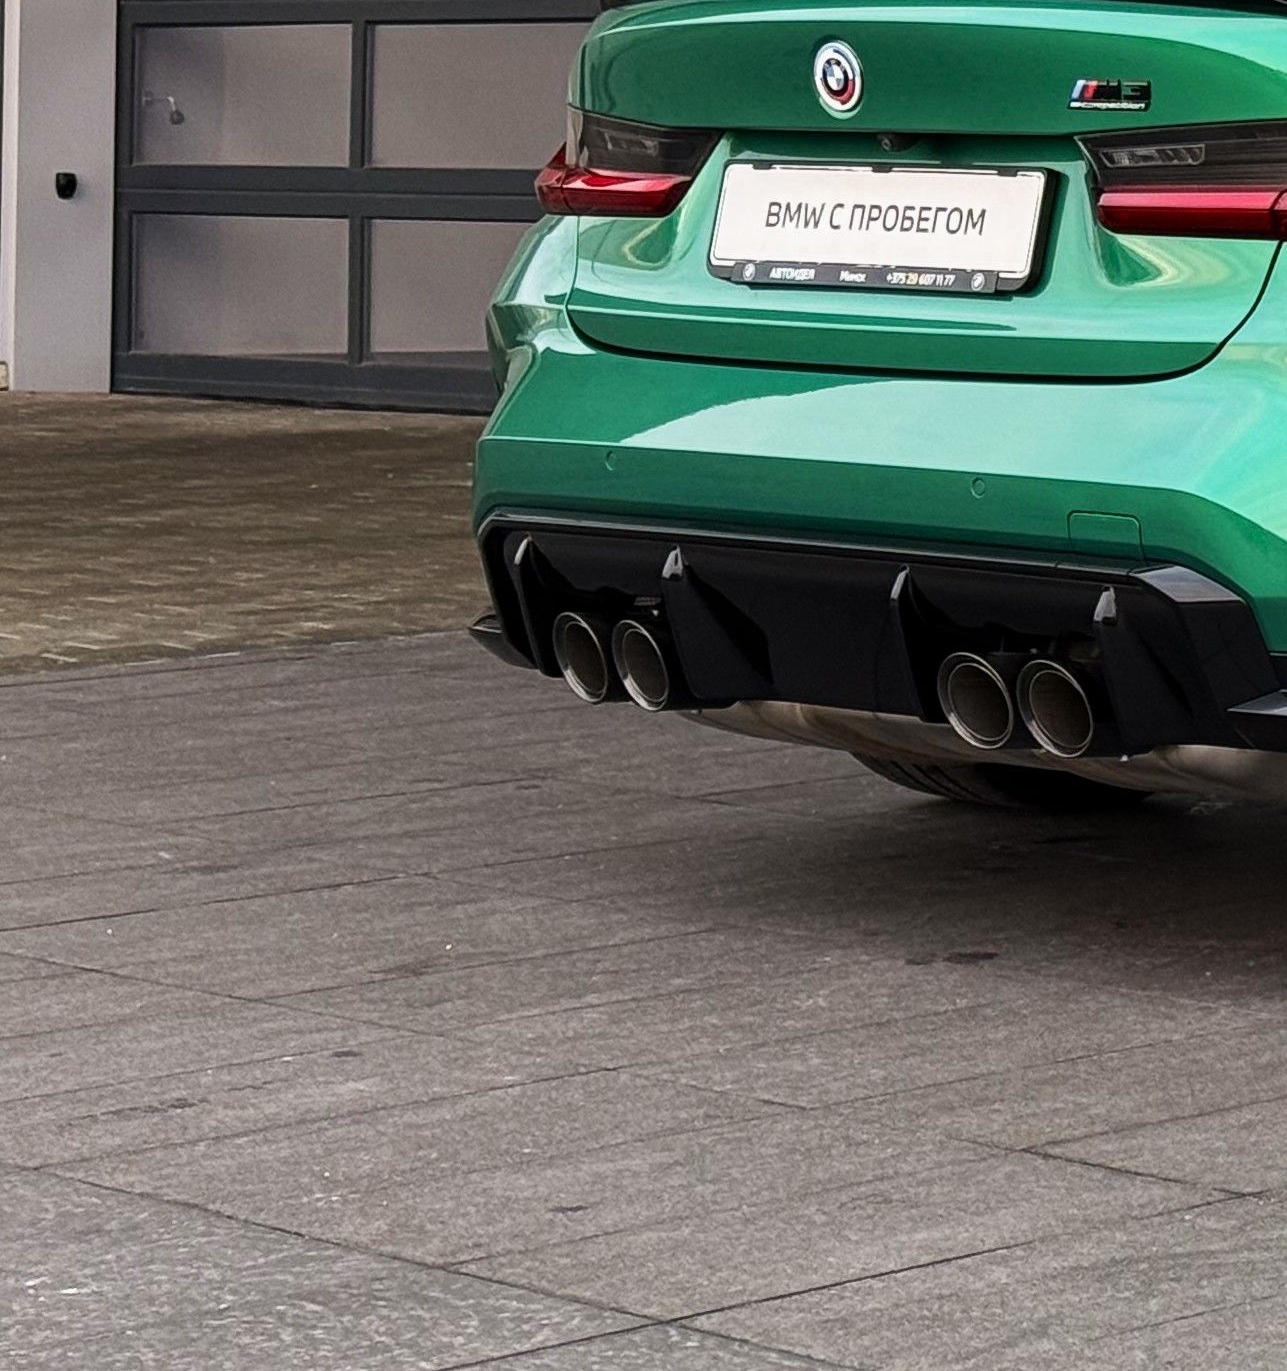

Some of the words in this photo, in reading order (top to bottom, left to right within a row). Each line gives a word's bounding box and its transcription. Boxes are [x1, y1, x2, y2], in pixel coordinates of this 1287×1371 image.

[765, 201, 826, 229] BMW
[829, 202, 845, 230] С
[848, 203, 986, 236] ПРОБЕГОМ
